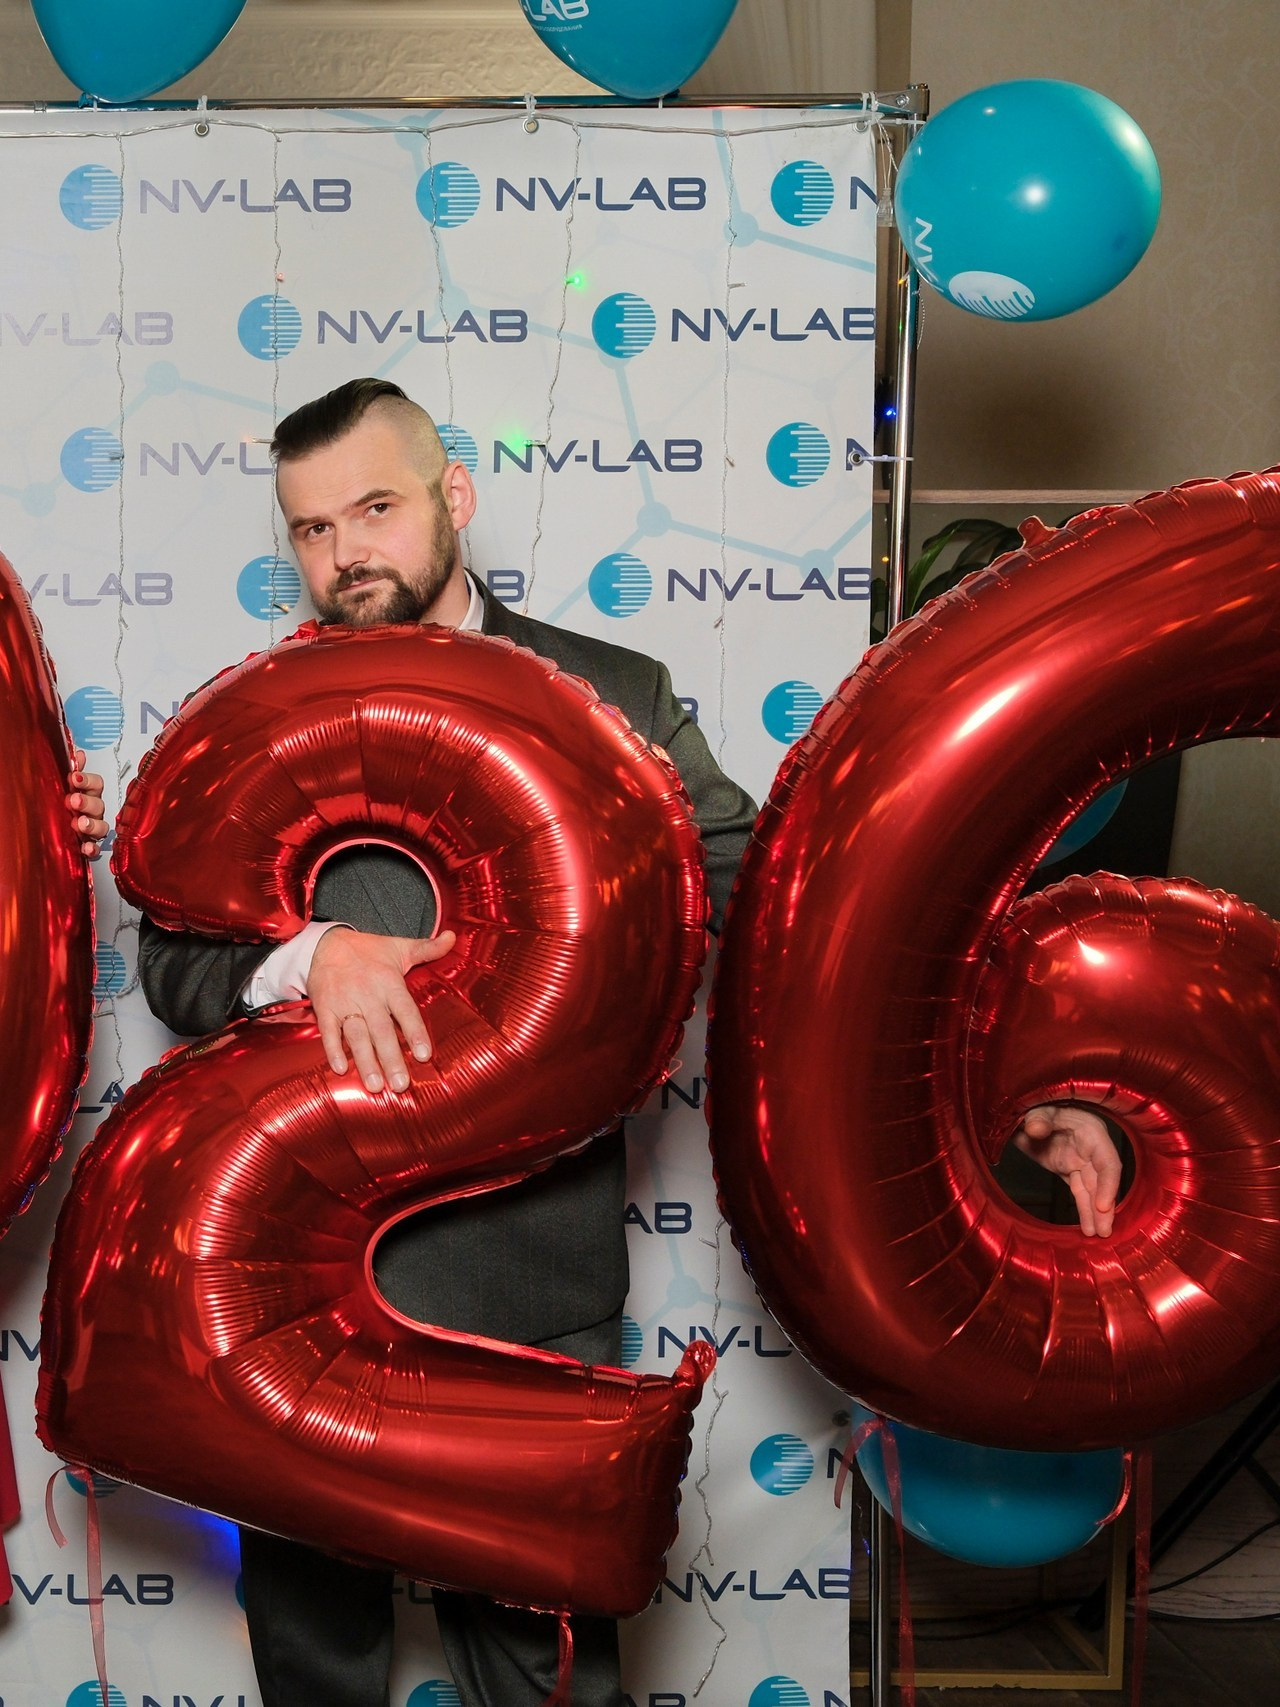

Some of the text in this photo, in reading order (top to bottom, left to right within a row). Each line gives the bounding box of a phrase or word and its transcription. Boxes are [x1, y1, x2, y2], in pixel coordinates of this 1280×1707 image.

[139, 178, 352, 214] NV-LAB
[496, 177, 707, 212] NV-LAB
[317, 309, 528, 344] NV-LAB
[139, 442, 274, 476] NV-L
[493, 439, 703, 474] NV-LAB
[11, 1574, 174, 1605] V-LAB
